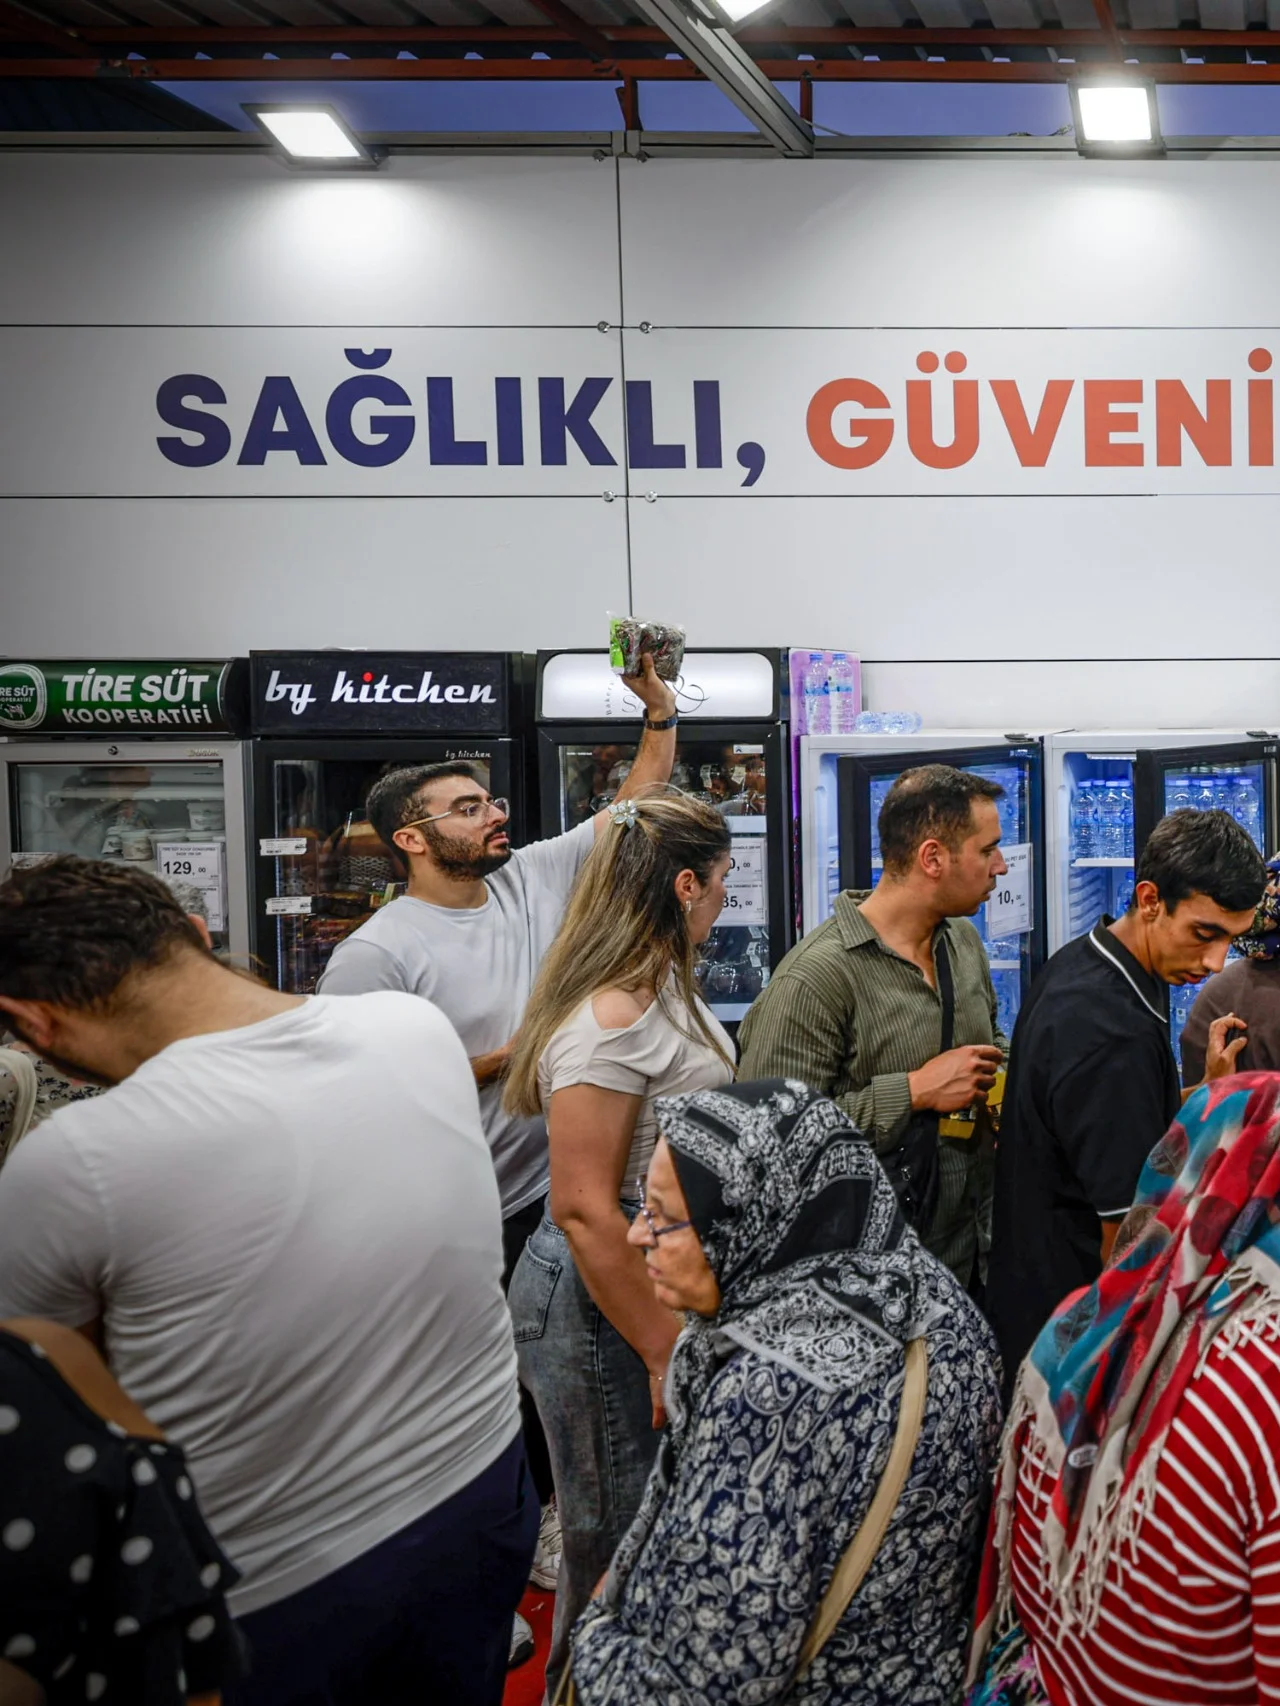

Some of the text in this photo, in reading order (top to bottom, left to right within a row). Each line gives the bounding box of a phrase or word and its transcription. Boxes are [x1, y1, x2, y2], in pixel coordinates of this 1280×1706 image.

[155, 348, 766, 487] SAĞLIKLI,
[13, 685, 35, 697] SÜT
[61, 667, 210, 702] TİRE SÜT
[264, 670, 497, 715] by kitchen
[61, 704, 213, 724] KOOPERATİFİ
